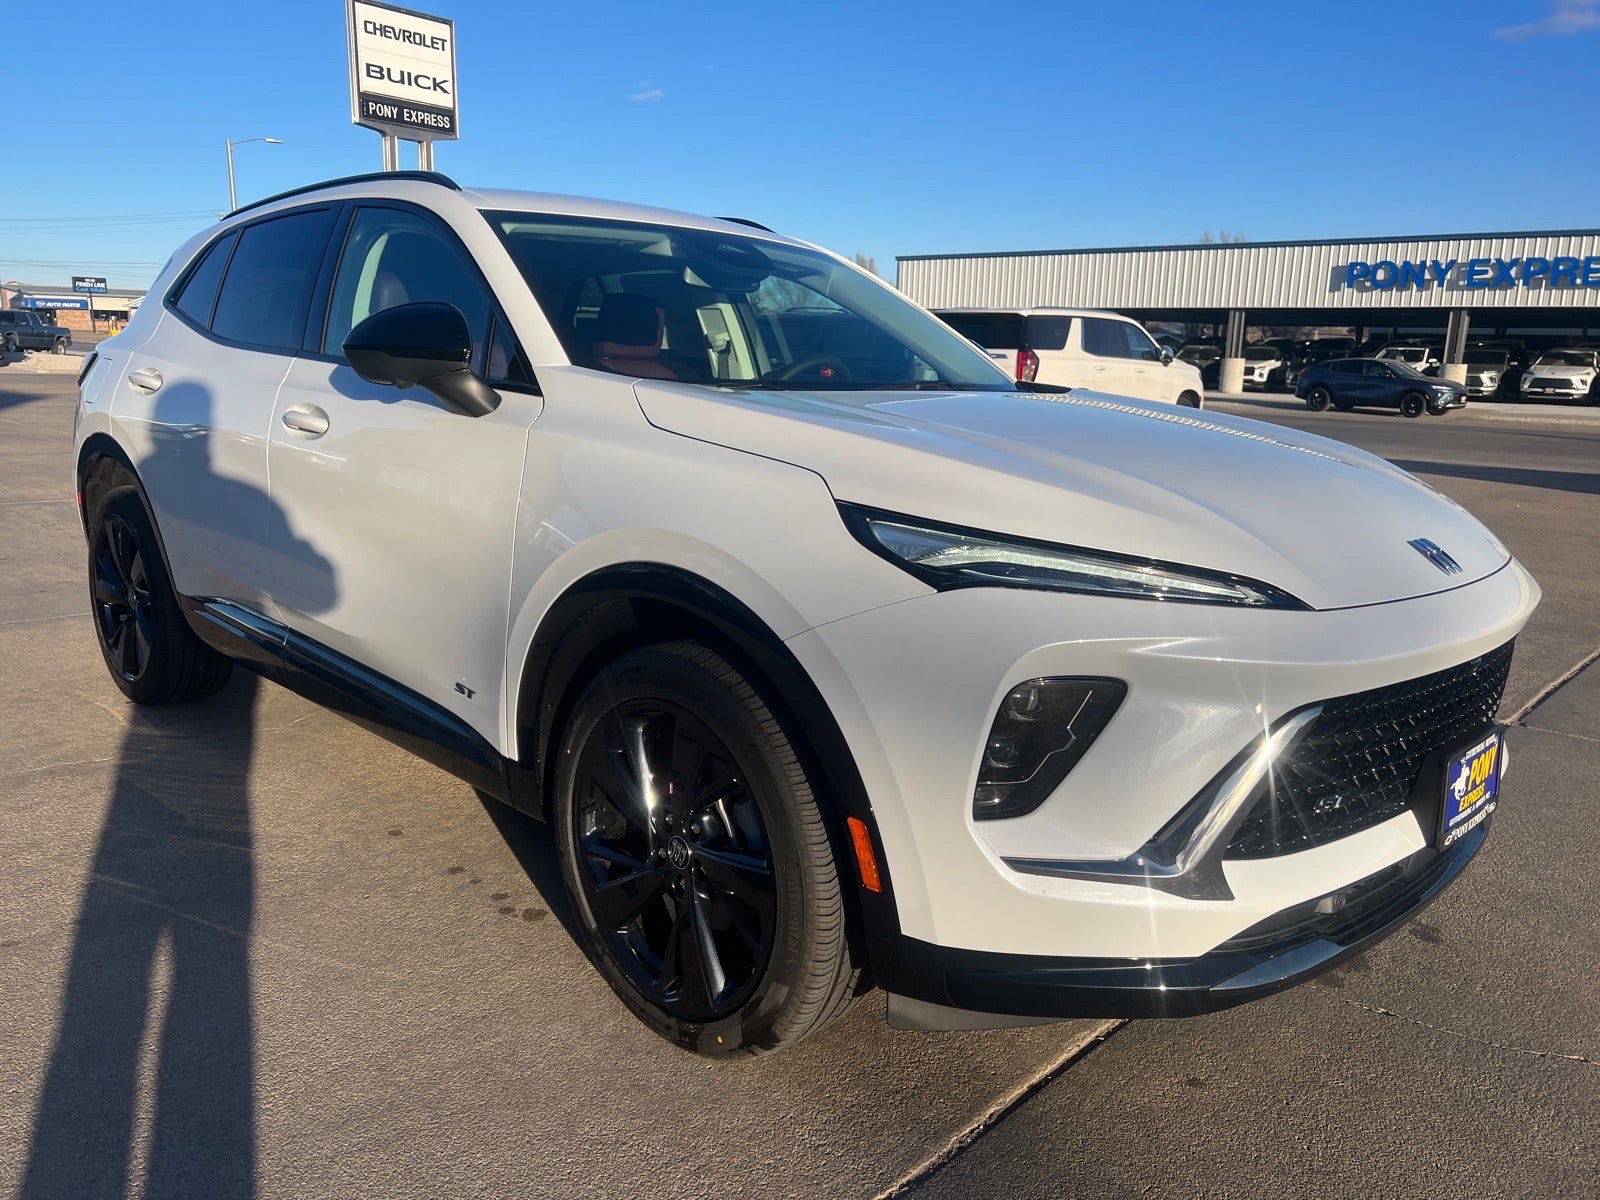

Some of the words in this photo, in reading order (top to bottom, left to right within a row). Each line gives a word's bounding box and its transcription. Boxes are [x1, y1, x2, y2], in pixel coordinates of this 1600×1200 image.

[363, 20, 447, 52] CHEVROLET
[365, 63, 450, 95] BUICK
[368, 101, 398, 119] PONY
[403, 109, 450, 129] EXPRESS
[1346, 259, 1457, 291] PONY
[454, 682, 476, 699] ST
[1468, 743, 1498, 791] PONY
[1459, 782, 1485, 812] EXPRESS
